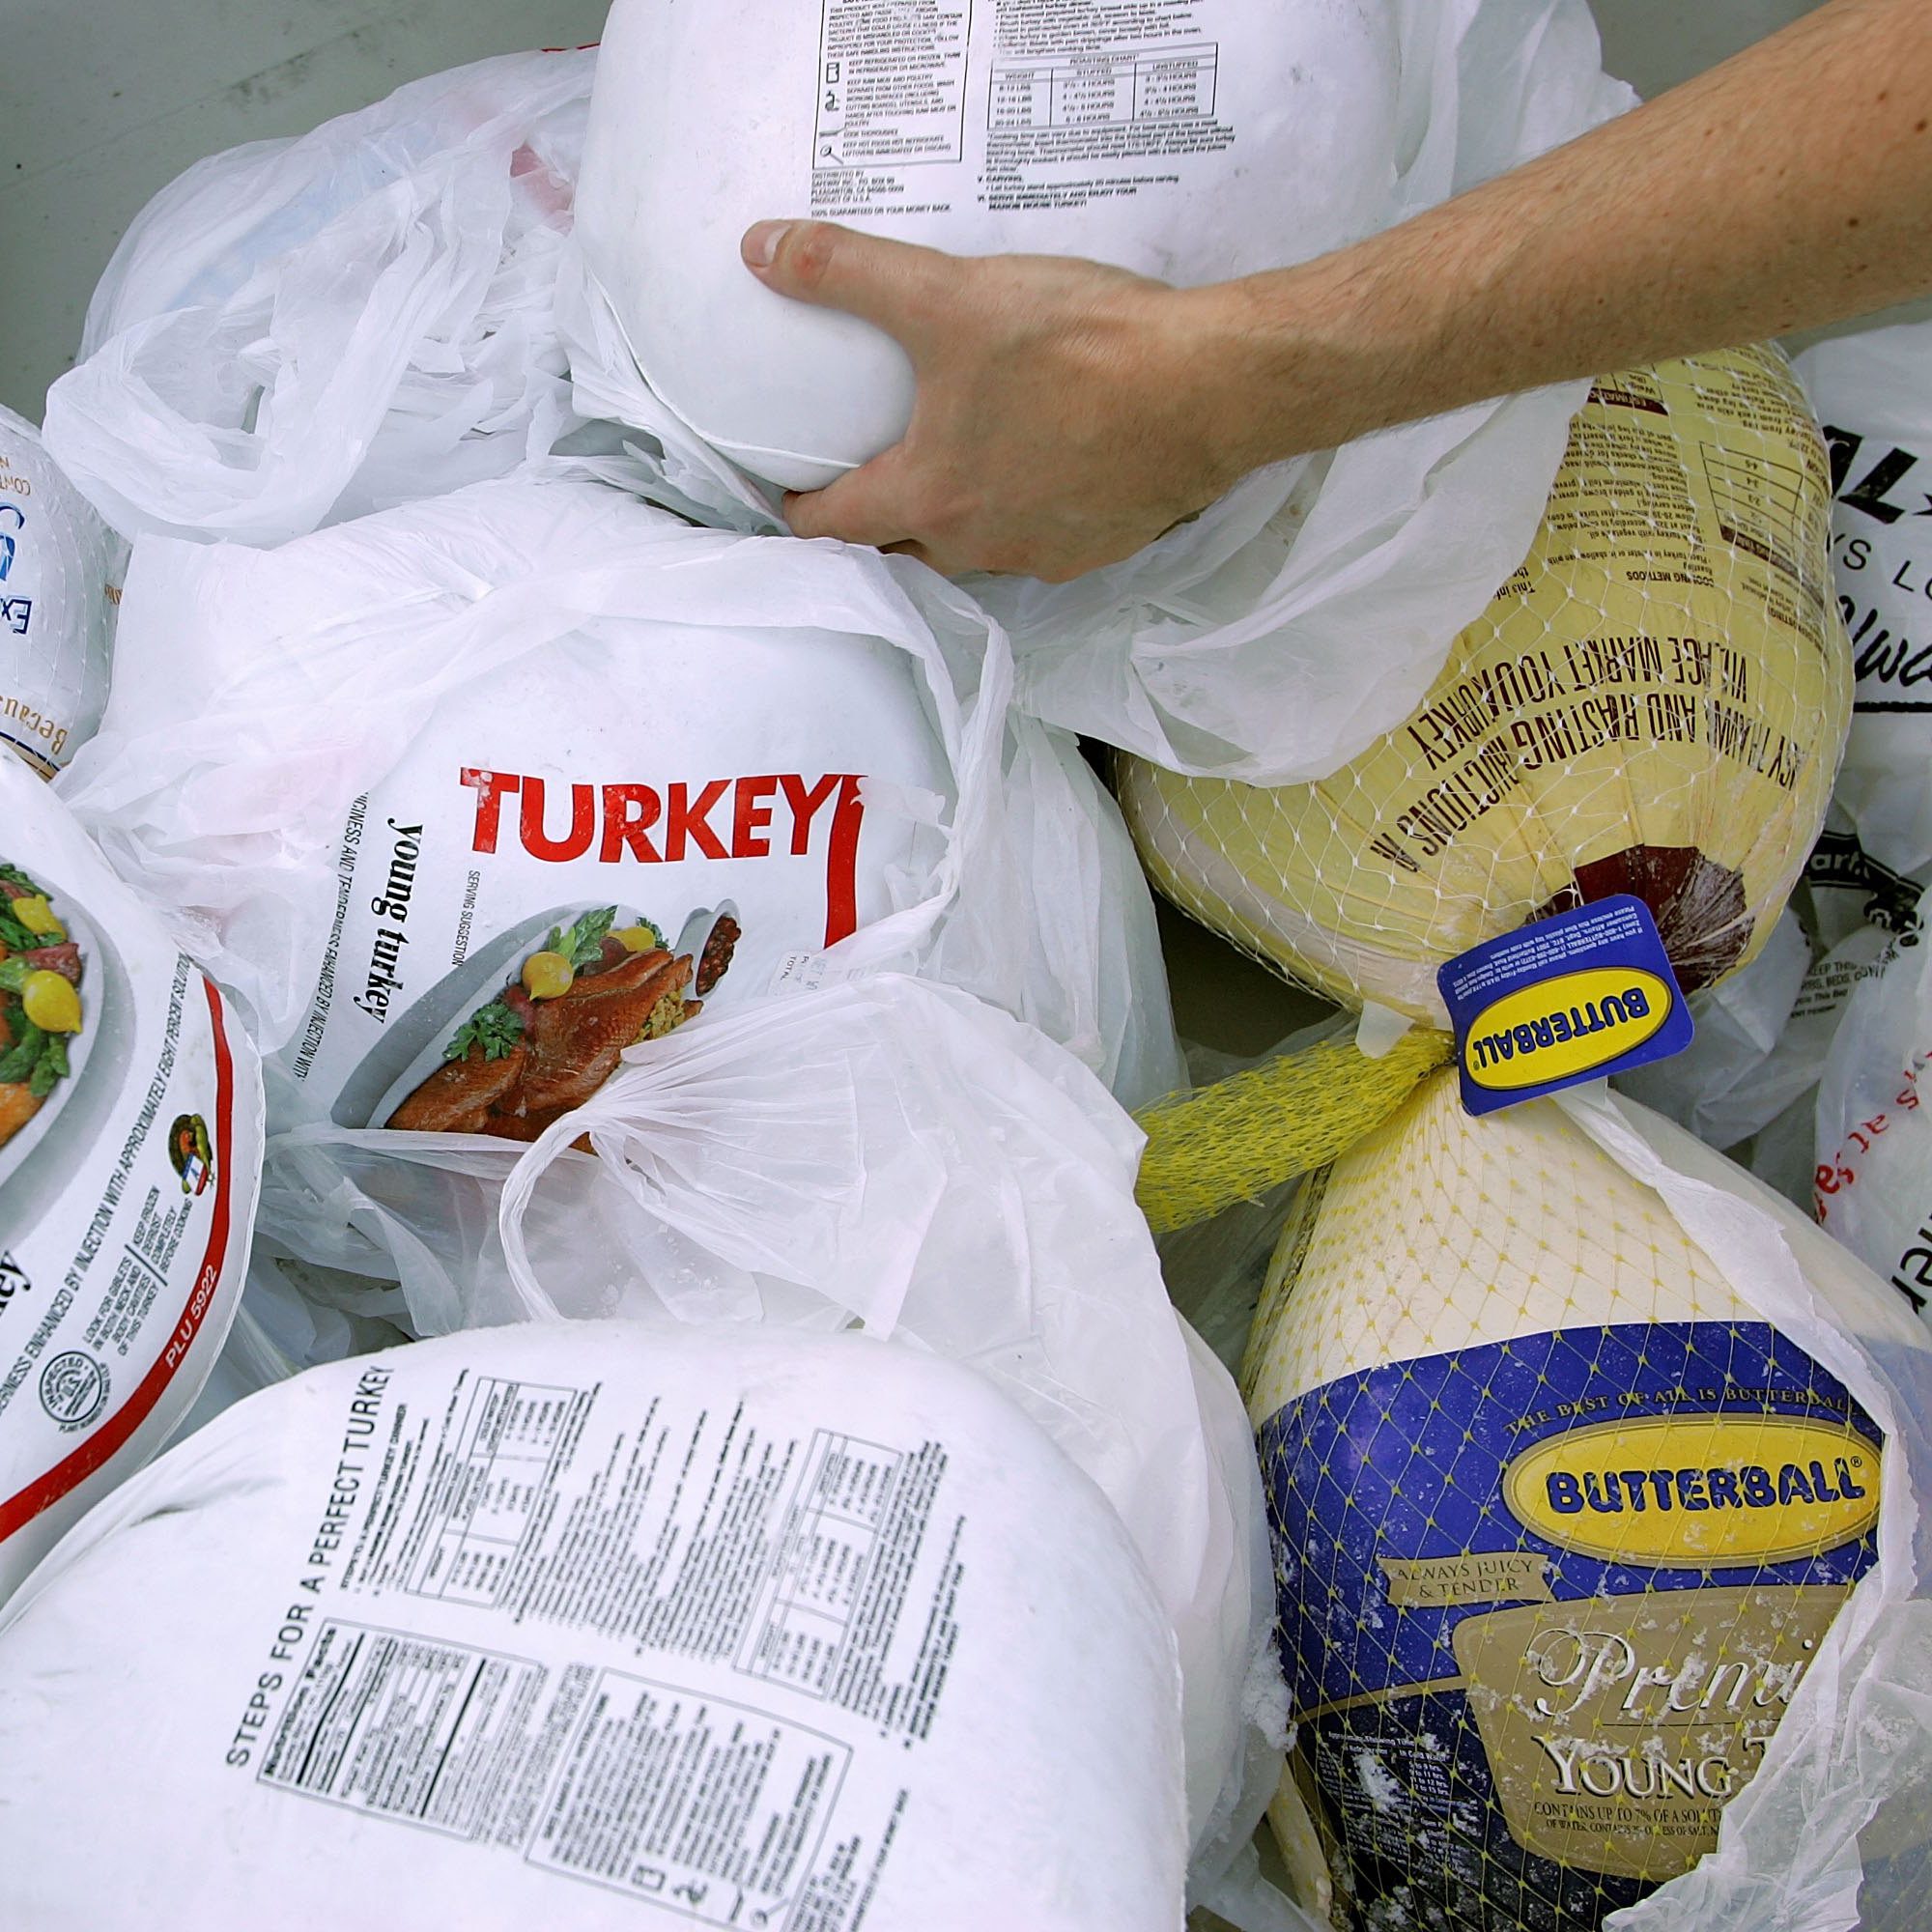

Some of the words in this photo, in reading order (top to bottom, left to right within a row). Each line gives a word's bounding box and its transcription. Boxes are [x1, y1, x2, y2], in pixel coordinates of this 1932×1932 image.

[1565, 551, 1576, 560] an
[1673, 571, 1715, 587] COOING
[0, 696, 69, 755] Becau
[1407, 682, 1485, 770] URKEY
[1647, 694, 1696, 743] AND
[460, 767, 840, 864] TURKEY
[337, 844, 357, 873] AND
[371, 817, 423, 923] young
[463, 869, 480, 909] SERVING
[451, 910, 472, 966] SUGGESTION
[314, 995, 330, 1013] BY
[354, 927, 406, 1024] turkey
[156, 1037, 179, 1077] EIGHT
[298, 1010, 327, 1058] INJECTION
[1473, 987, 1650, 1068] BUTTERBALL
[117, 1073, 169, 1171] APPROXIMATELY
[101, 1167, 129, 1207] WITH
[129, 1219, 147, 1247] KEEP
[139, 1184, 161, 1222] FROZEN
[71, 1204, 116, 1272] INJECTION
[140, 1212, 163, 1255] DEFROST
[148, 1205, 179, 1264] COMPLETELY
[156, 1236, 179, 1273] BEFORE
[171, 1196, 194, 1237] COOKING
[63, 1265, 86, 1293] BY
[81, 1314, 102, 1344] LOOK
[96, 1293, 113, 1317] FOR
[106, 1255, 133, 1296] GIBLETS
[91, 1337, 104, 1351] IN
[98, 1311, 118, 1339] BOTH
[111, 1287, 131, 1312] NECK
[125, 1264, 143, 1287] AND
[110, 1316, 130, 1343] BODY
[125, 1273, 152, 1316] CAVITIES
[22, 1287, 75, 1359] ENHANCED
[116, 1340, 130, 1356] OF
[124, 1318, 142, 1342] THIS
[135, 1280, 161, 1320] TURKEY
[162, 1318, 196, 1368] PLU
[185, 1264, 219, 1321] 5922
[340, 1360, 394, 1460] TURKEY
[307, 1459, 364, 1568] PERFECT
[1546, 1457, 1865, 1515] BUTTERBALL
[298, 1570, 326, 1595] A
[1419, 1584, 1432, 1598] &
[1438, 1577, 1519, 1597] TENDER
[268, 1599, 314, 1665] FOR
[223, 1667, 286, 1770] STEPS
[1531, 1735, 1732, 1798] YOUNG
[1598, 1806, 1611, 1820] UP
[1617, 1808, 1632, 1821] TO
[1654, 1809, 1668, 1822] OF
[1672, 1809, 1680, 1821] A
